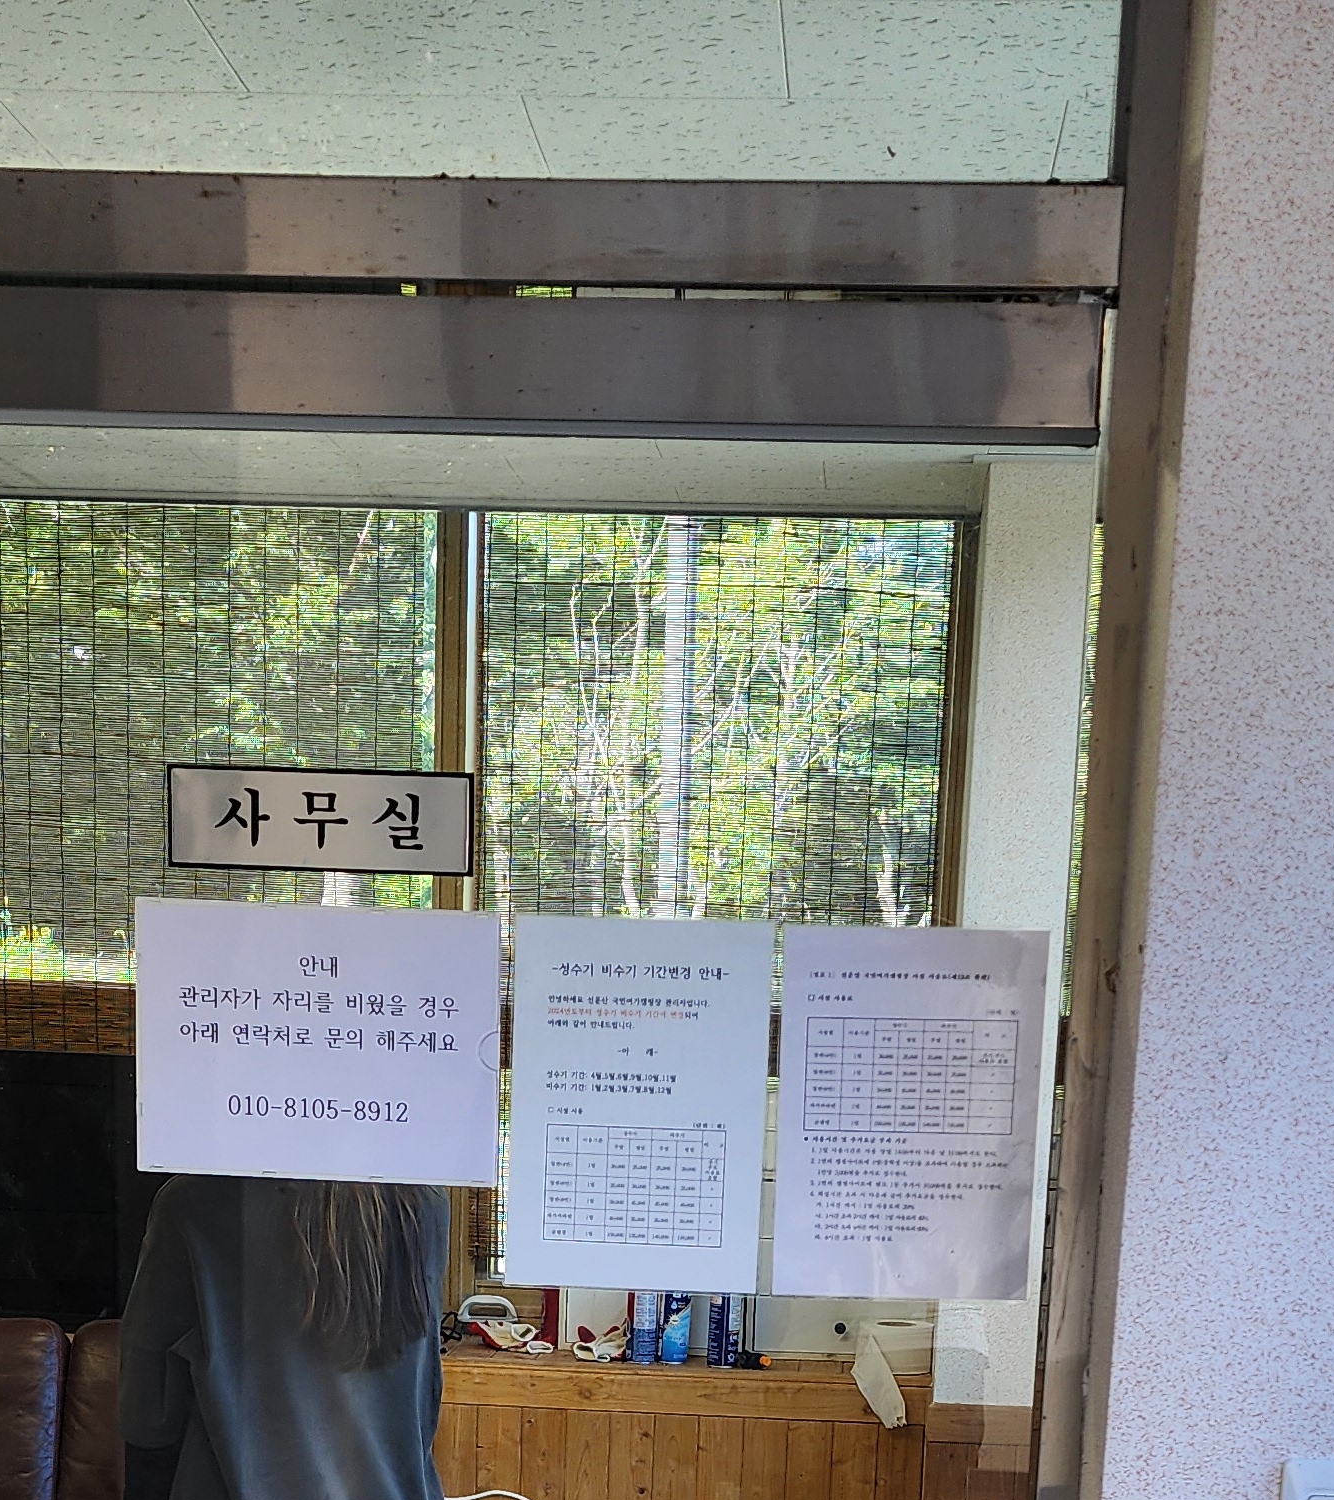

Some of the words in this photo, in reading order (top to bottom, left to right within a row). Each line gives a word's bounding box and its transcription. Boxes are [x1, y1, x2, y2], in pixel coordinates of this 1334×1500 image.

[215, 787, 424, 850] 사무실
[299, 955, 339, 979] 안내
[601, 964, 637, 979] 비수기
[644, 965, 691, 980] 기간변경
[179, 986, 261, 1012] 관리자가
[272, 990, 334, 1014] 자리를
[346, 993, 407, 1017] 비웠을
[418, 996, 459, 1020] 경우
[180, 1022, 219, 1045] 아래
[232, 1024, 313, 1048] 연락처로
[324, 1029, 364, 1051] 문의
[376, 1030, 458, 1053] 해주세요
[227, 1094, 409, 1123] 010-8105-8912
